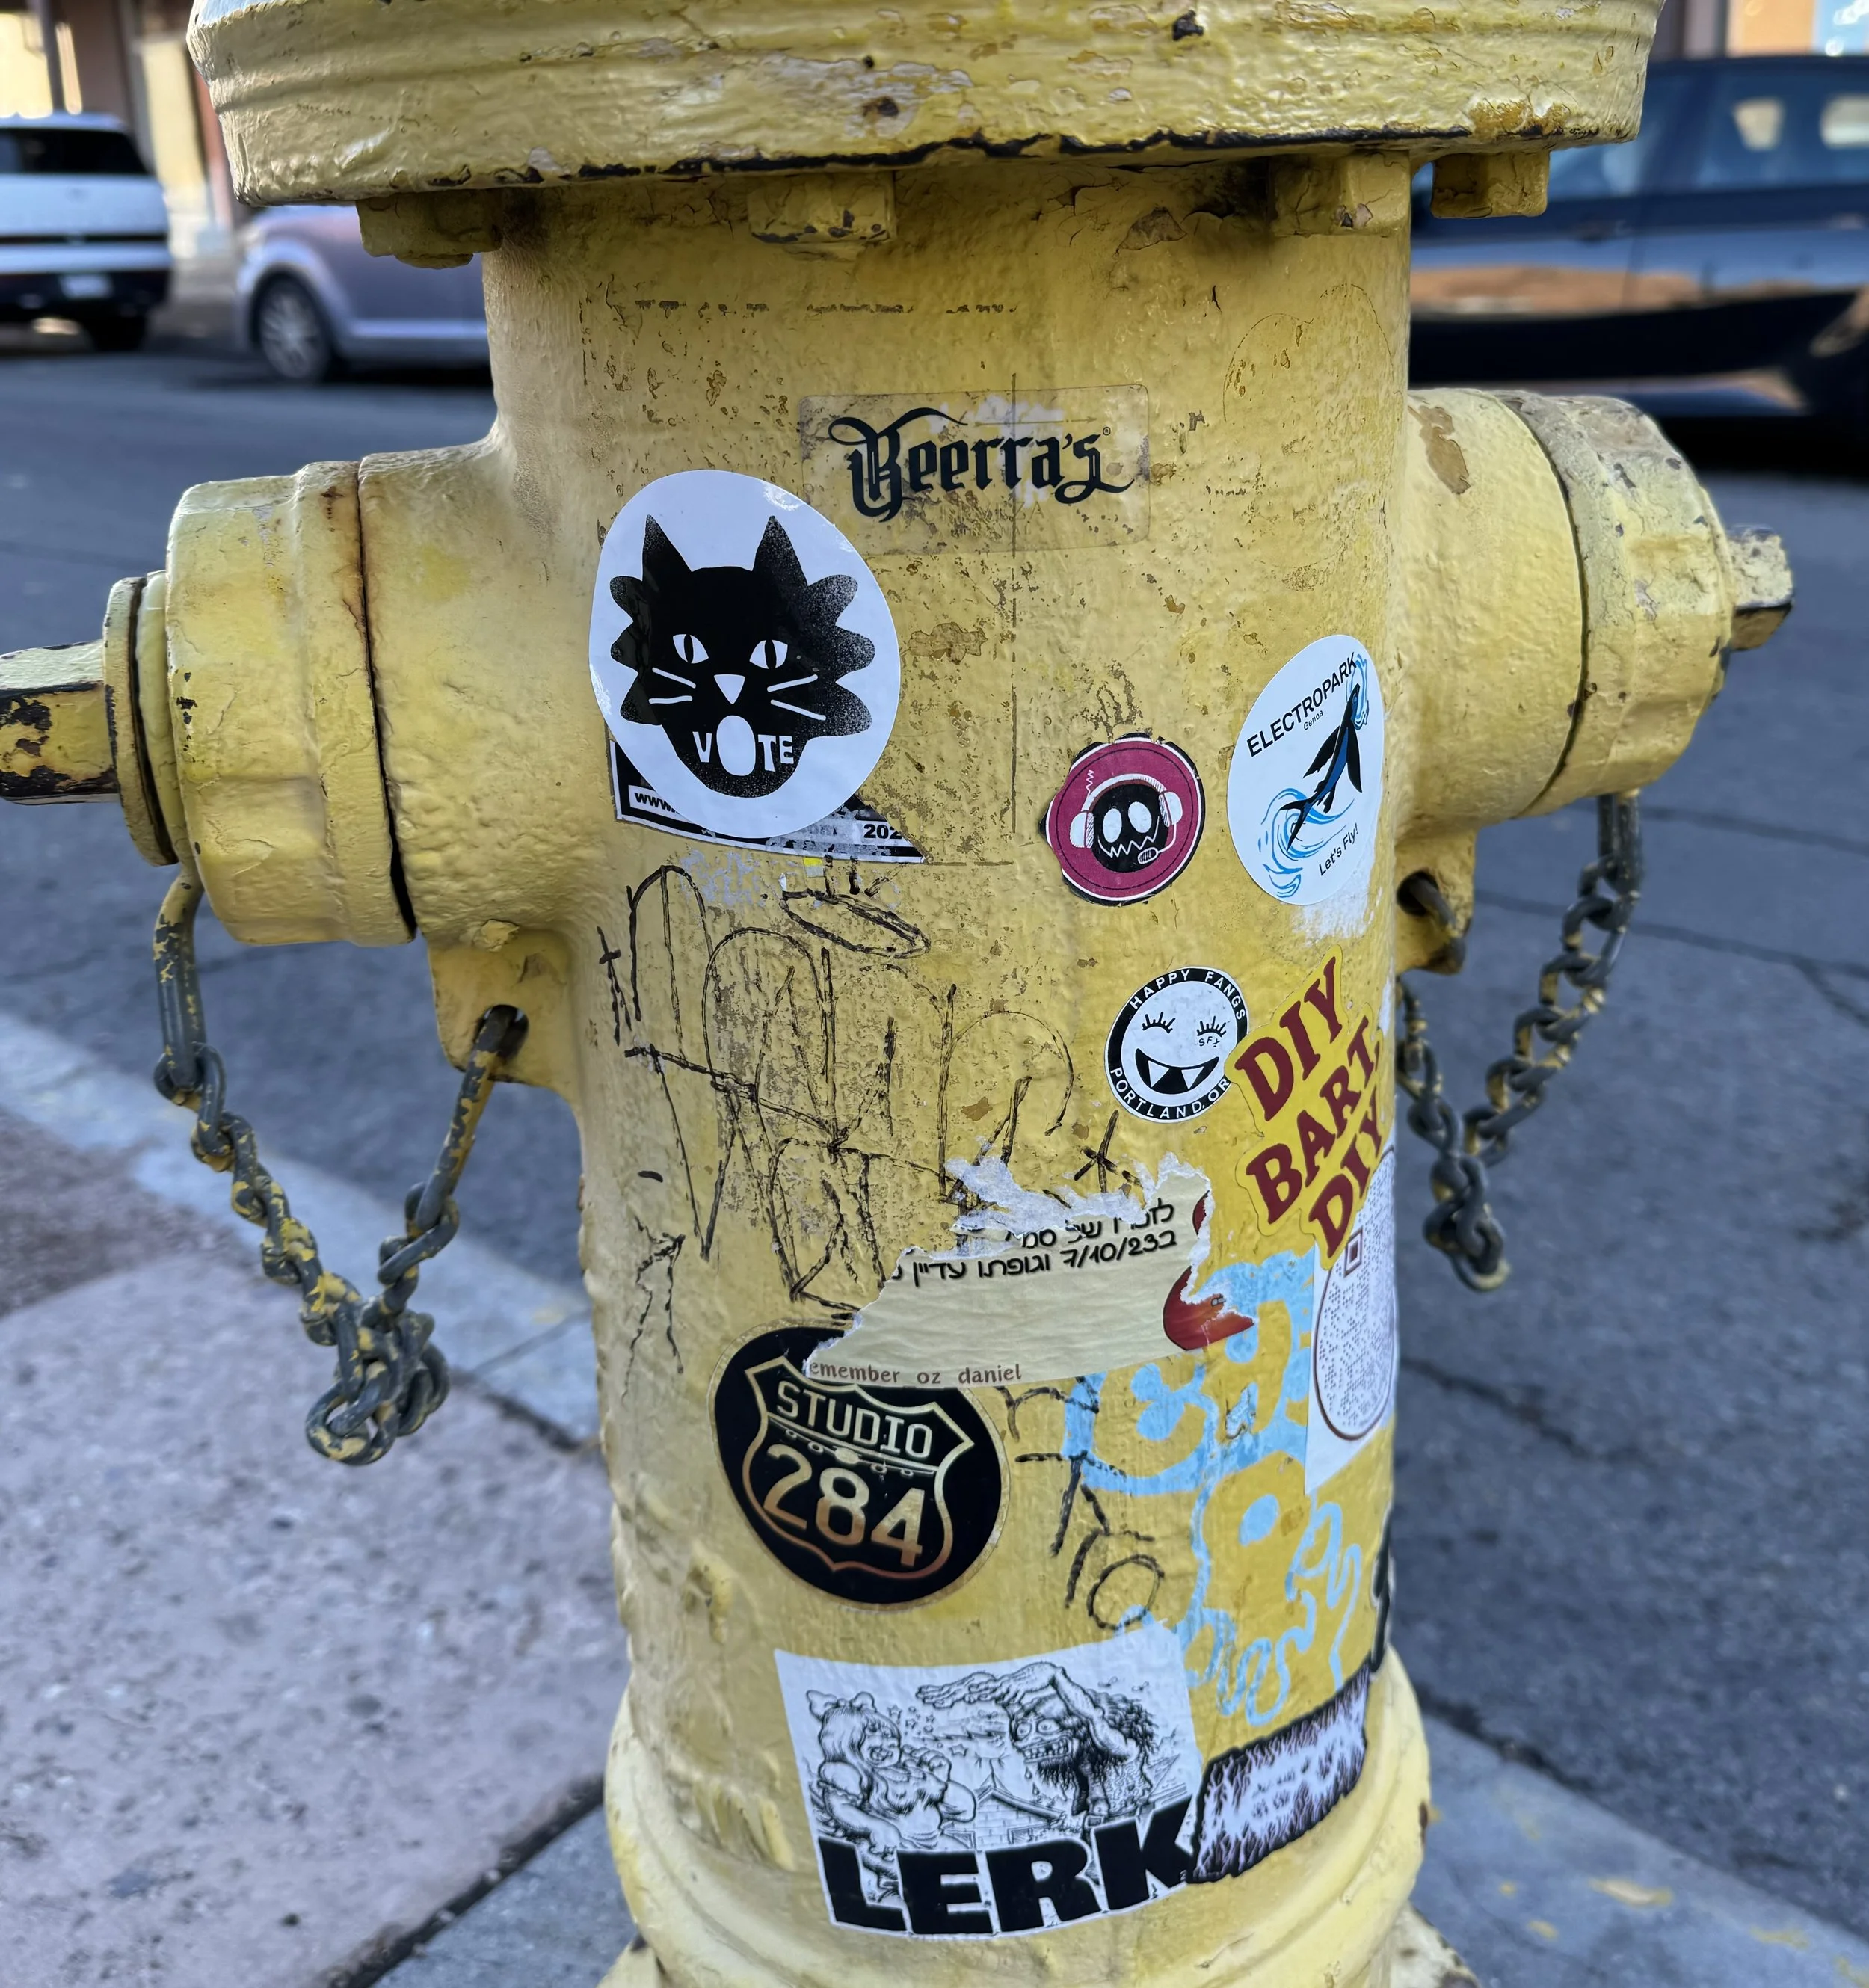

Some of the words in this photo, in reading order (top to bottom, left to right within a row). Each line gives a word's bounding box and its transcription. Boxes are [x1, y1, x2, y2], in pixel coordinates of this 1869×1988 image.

[1246, 651, 1357, 757] ELECTROPARK
[1303, 710, 1324, 731] Genoa
[692, 715, 794, 776] VOTE
[1319, 846, 1342, 876] Let's
[1343, 823, 1359, 851] Fly!
[1130, 969, 1190, 1009] HAPPY
[1204, 970, 1246, 1020] FANGS
[1234, 956, 1343, 1121] DIY
[1110, 1067, 1205, 1119] PORTLAND,
[1208, 1078, 1231, 1102] OR
[1308, 1085, 1382, 1259] DIY
[913, 1260, 967, 1287] עדיין
[978, 1253, 1051, 1278] וגופתו
[917, 1371, 941, 1384] oz
[958, 1364, 1022, 1384] daniel
[777, 1380, 933, 1458] STUDIO
[763, 1444, 926, 1567] 284
[818, 1793, 1197, 1935] LERK
